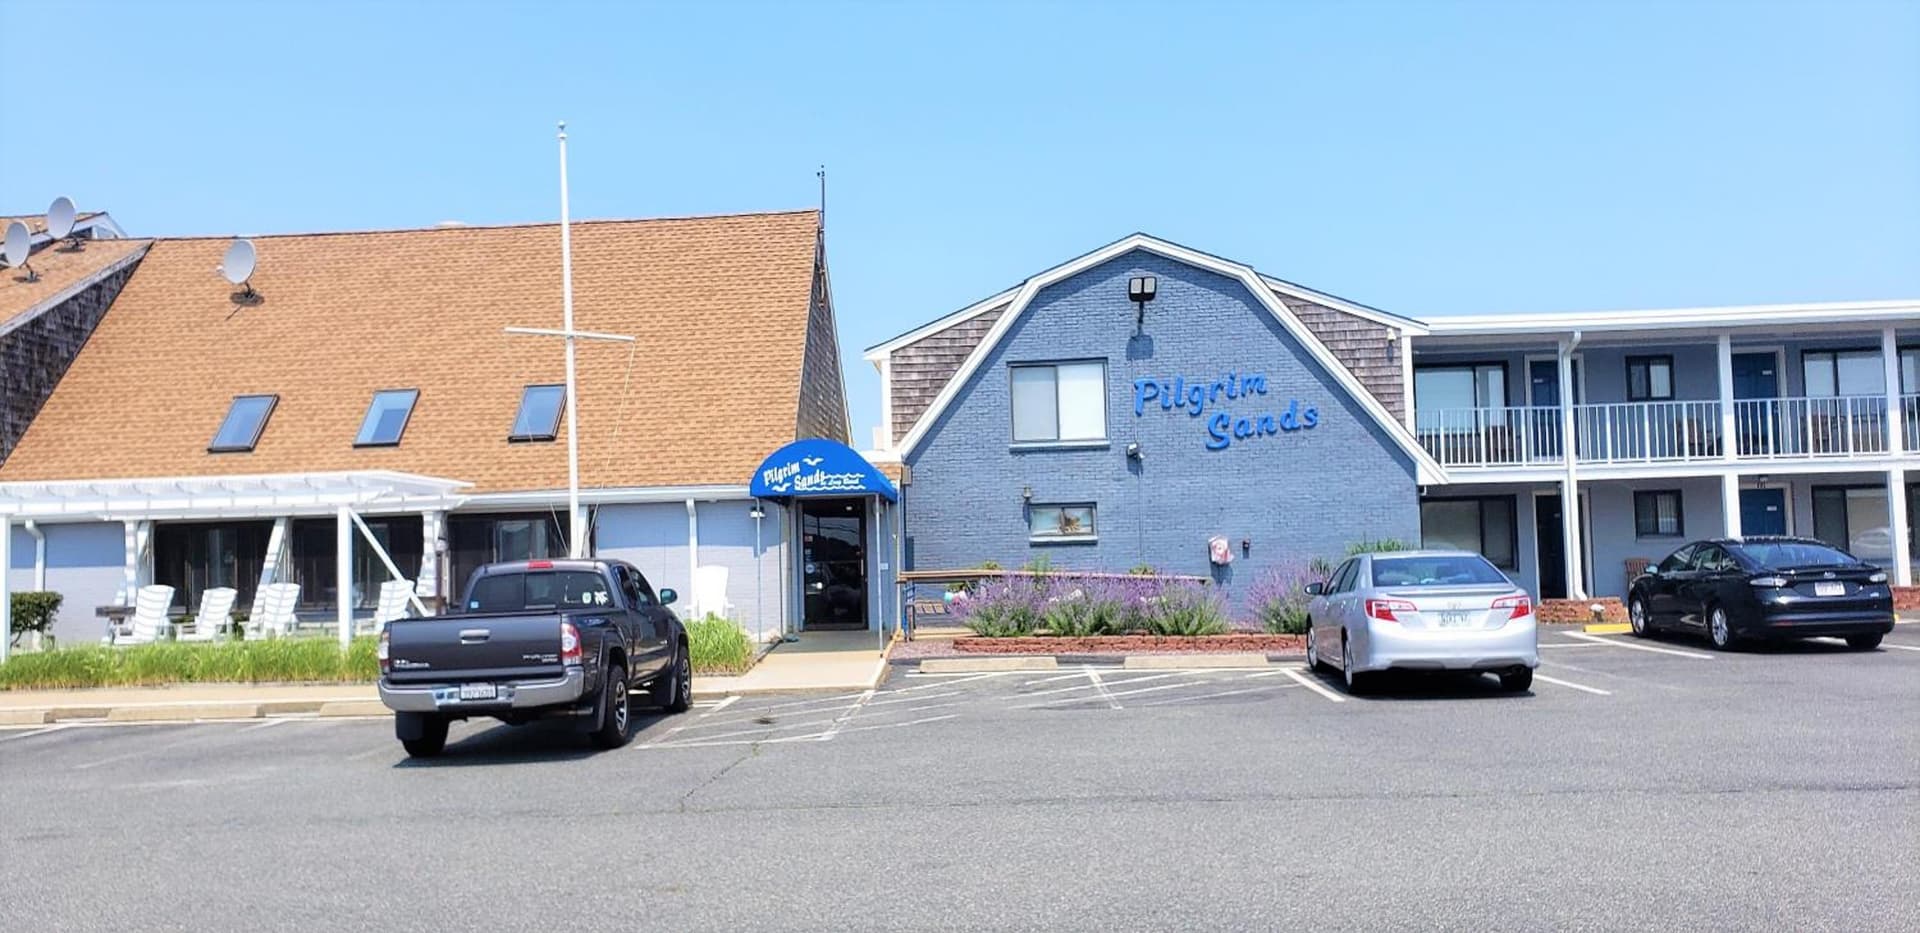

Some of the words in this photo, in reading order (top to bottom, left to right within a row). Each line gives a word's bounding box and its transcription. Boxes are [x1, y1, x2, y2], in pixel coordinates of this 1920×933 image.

[1134, 373, 1267, 416] Pilgrim
[1206, 401, 1319, 450] Sands
[763, 462, 800, 487] Pilgrim
